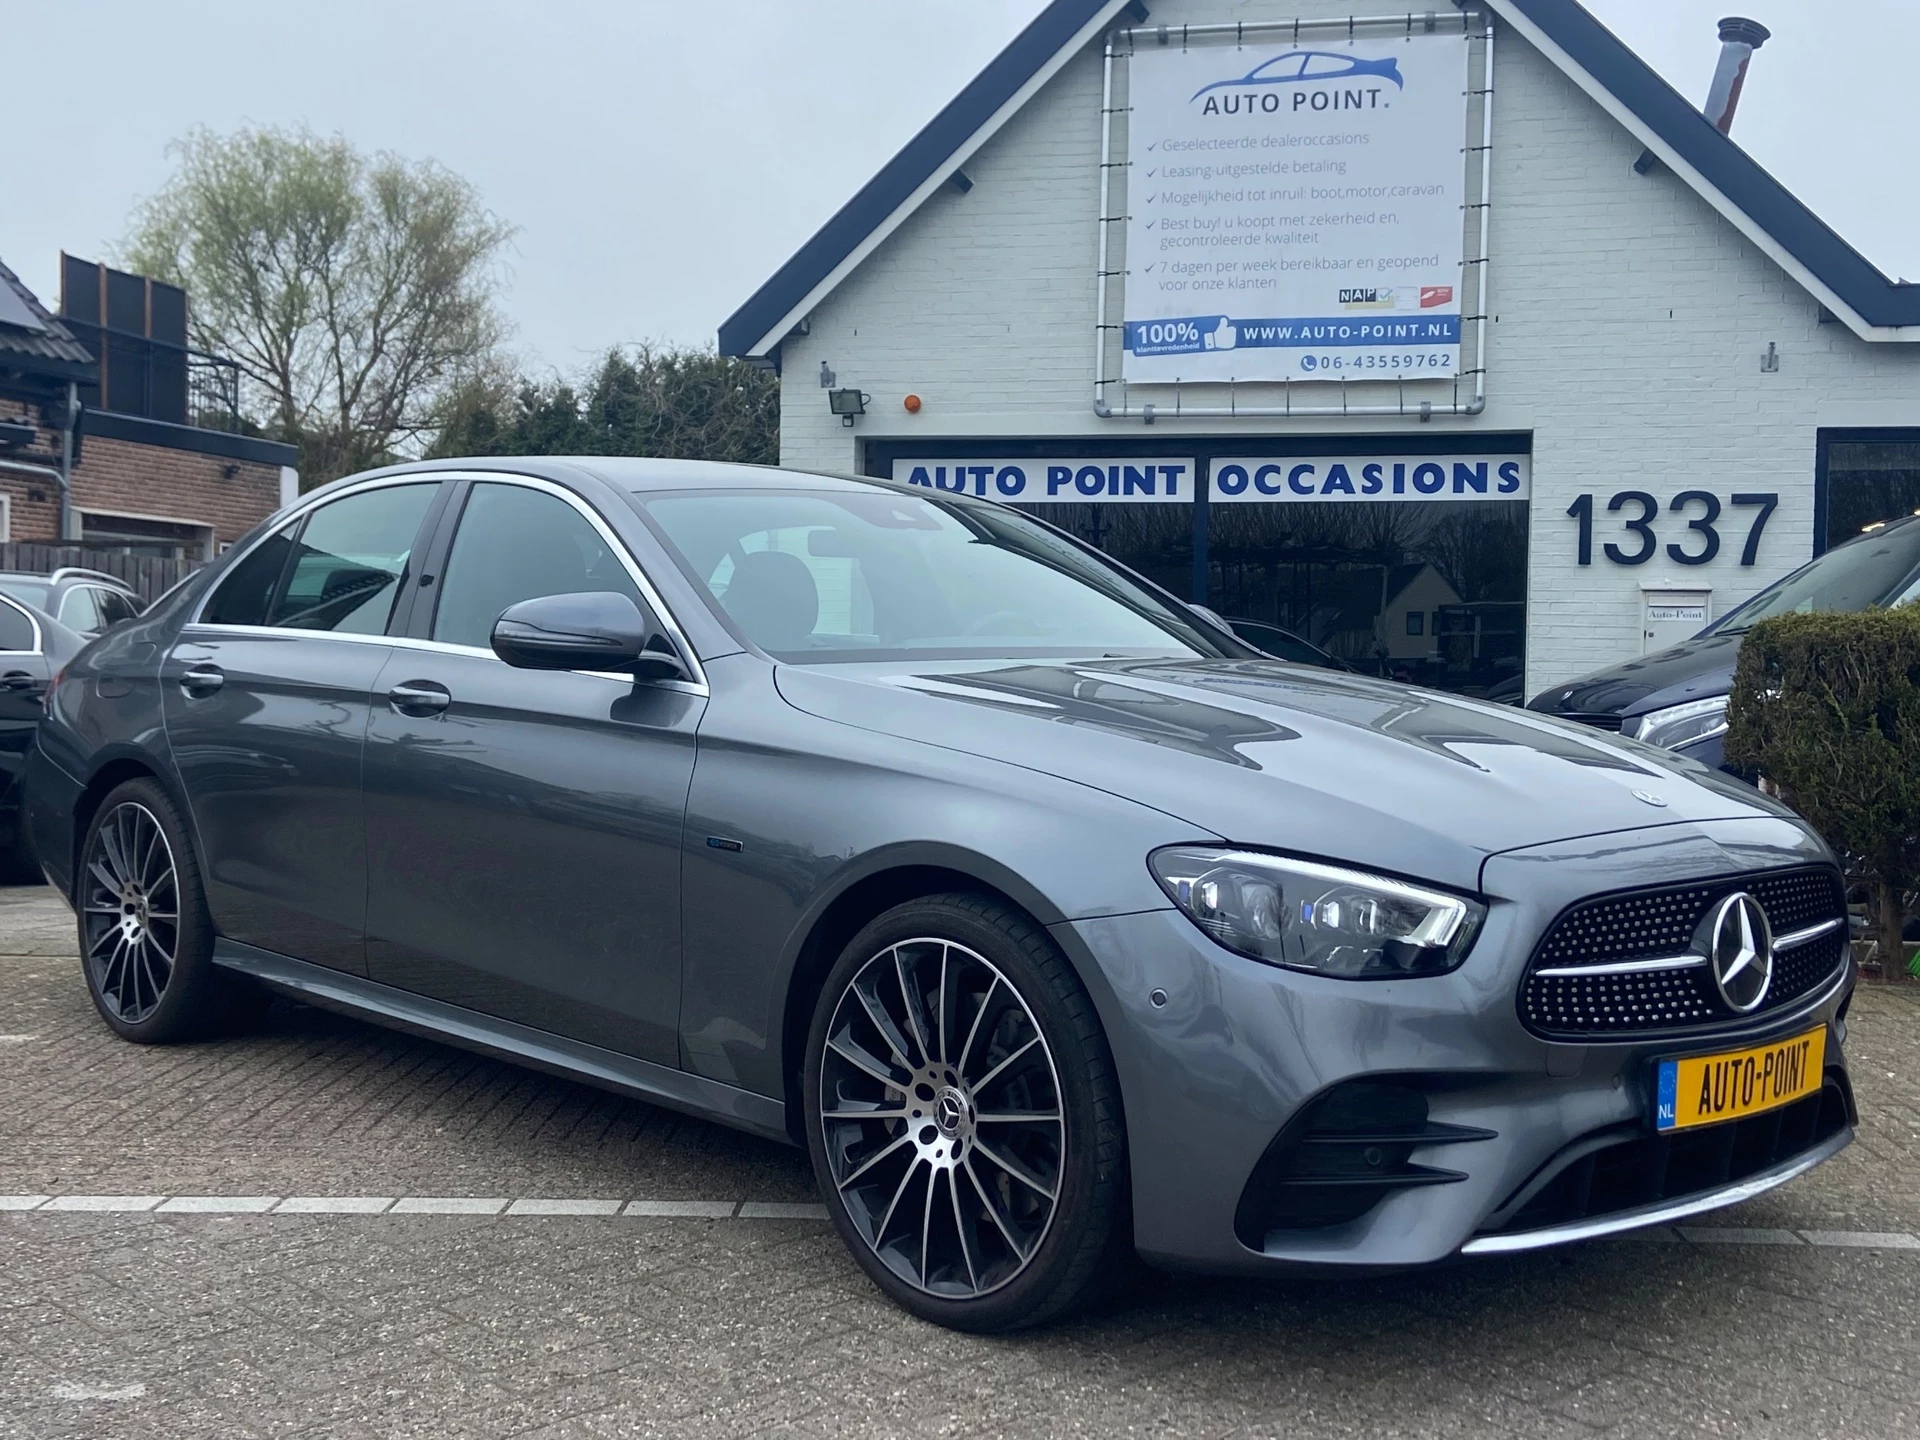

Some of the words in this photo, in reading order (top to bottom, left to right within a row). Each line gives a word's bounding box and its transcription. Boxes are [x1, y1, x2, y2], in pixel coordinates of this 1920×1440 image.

[1203, 93, 1280, 115] AUTO
[1162, 138, 1257, 152] Geselecteerde
[1261, 133, 1370, 148] dealeroccasions
[1161, 161, 1289, 180] Leasing-uitgestelde
[1292, 160, 1347, 175] betaling
[1161, 189, 1244, 206] Mogelijkheid
[1247, 189, 1266, 201] tot
[1270, 186, 1307, 200] inruil:
[1161, 217, 1190, 230] Best
[1193, 216, 1220, 232] buy!
[1225, 219, 1233, 228] u
[1237, 215, 1275, 230] koopt
[1280, 215, 1305, 227] met
[1309, 211, 1375, 226] zekerheid
[1379, 213, 1400, 225] en,
[1160, 233, 1260, 251] gecontroleerde
[1265, 231, 1319, 245] kwaliteit
[1160, 261, 1168, 273] 7
[1171, 260, 1212, 276] dagen
[1216, 262, 1238, 275] per
[1242, 258, 1277, 271] week
[1281, 256, 1353, 270] bereikbaar
[1357, 257, 1373, 268] en
[1377, 254, 1439, 272] geopend
[1159, 280, 1188, 290] voor
[1192, 279, 1224, 290] onze
[1228, 277, 1277, 289] klanten
[1340, 288, 1376, 302] NAP
[1137, 322, 1199, 344] 100%
[1243, 323, 1453, 340] WWW.AUTO-POINT.NL
[1321, 354, 1450, 369] 06-43559762
[908, 465, 1026, 496] AUTO
[1047, 464, 1186, 496] POINT
[1216, 461, 1520, 496] OCCASIONS
[1566, 490, 1778, 566] 1337
[1648, 609, 1702, 619] Auto-Point
[1698, 1040, 1810, 1115] AUTO-POINT
[1658, 1103, 1674, 1120] NL
